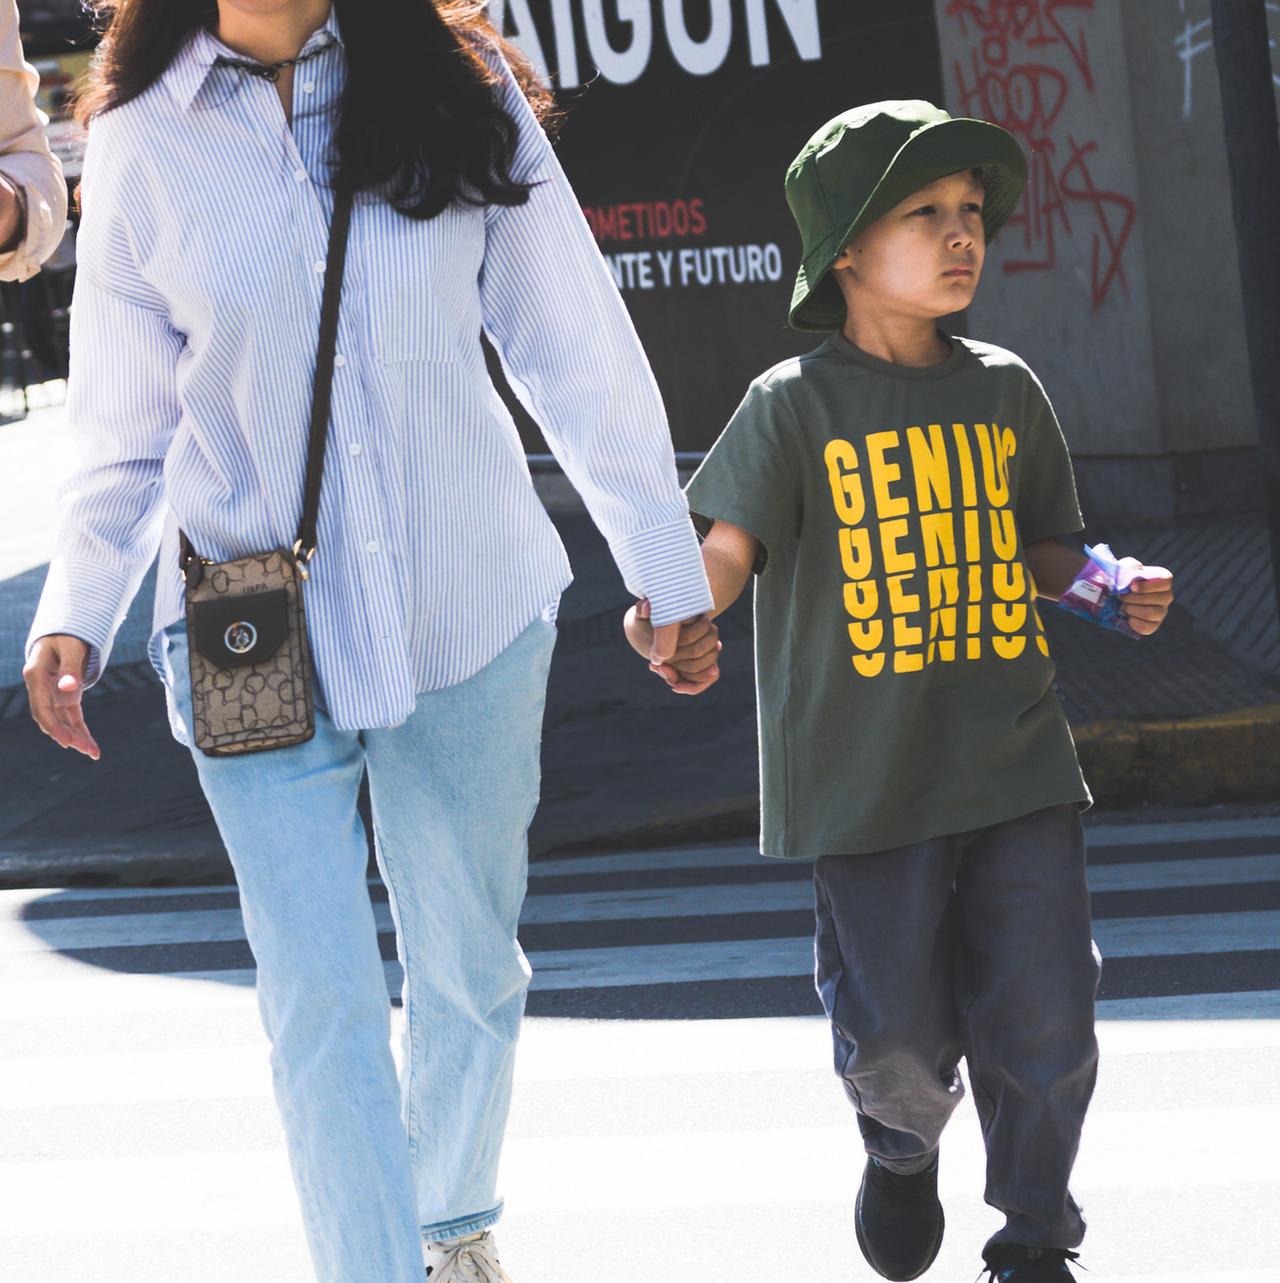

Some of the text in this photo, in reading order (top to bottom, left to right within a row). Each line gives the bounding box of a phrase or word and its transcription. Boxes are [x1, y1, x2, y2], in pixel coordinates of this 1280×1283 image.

[604, 243, 783, 290] NTE Y FUTURO
